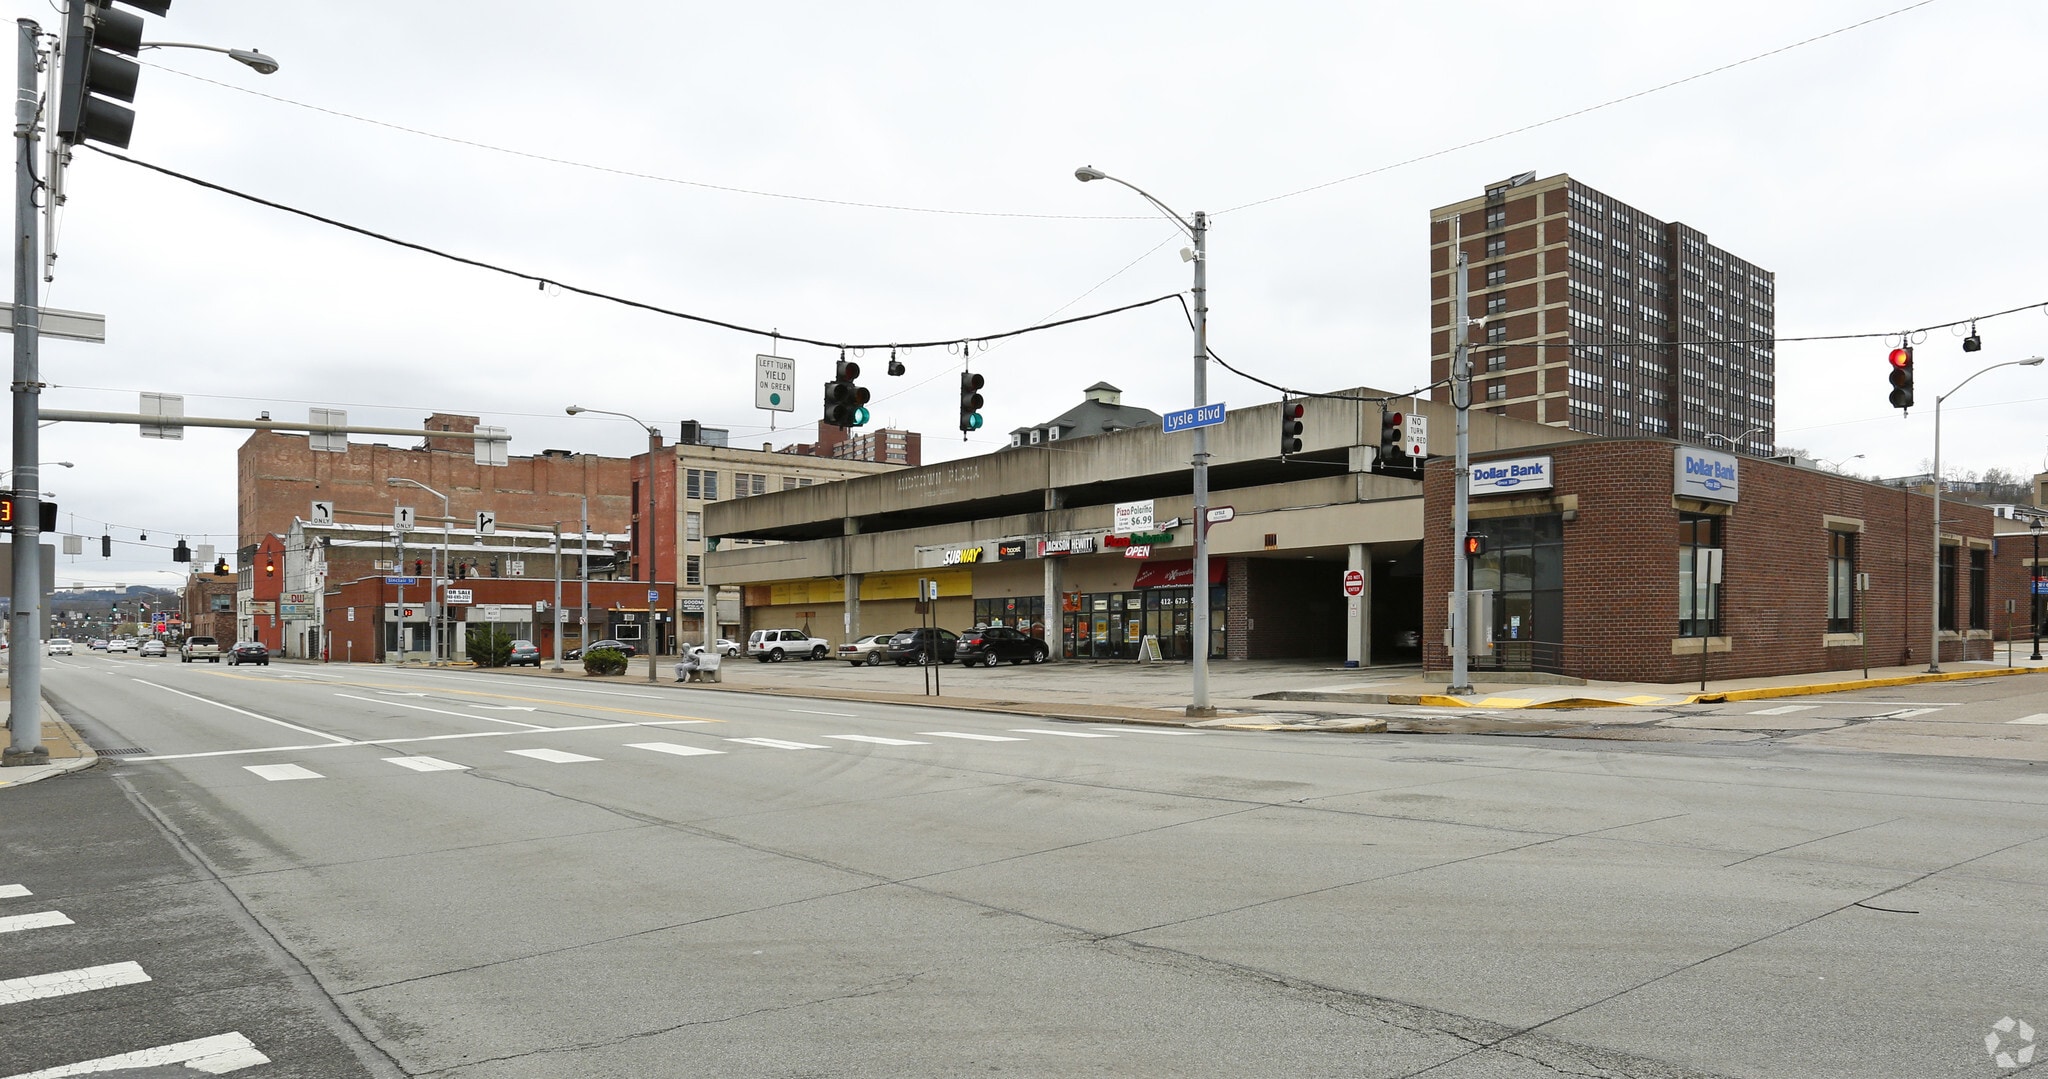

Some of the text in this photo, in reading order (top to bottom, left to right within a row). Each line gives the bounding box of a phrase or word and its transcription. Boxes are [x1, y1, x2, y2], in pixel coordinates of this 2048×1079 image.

[759, 359, 792, 370] LEFT TURN
[765, 370, 787, 381] YIELD
[760, 381, 791, 391] ON GREEN
[1168, 405, 1220, 430] Lysle Blvd
[1412, 417, 1422, 426] NO
[1410, 427, 1424, 435] TURN
[1407, 435, 1427, 444] ON RED
[1474, 463, 1543, 481] Dollar Bank
[1686, 456, 1736, 481] Dollar Bank
[1, 501, 10, 521] 3
[1116, 507, 1131, 517] Pizza
[1131, 515, 1152, 526] $6.99
[1071, 537, 1093, 550] HEWITT
[943, 546, 982, 565] SUBWAY
[1125, 545, 1150, 557] OPEN
